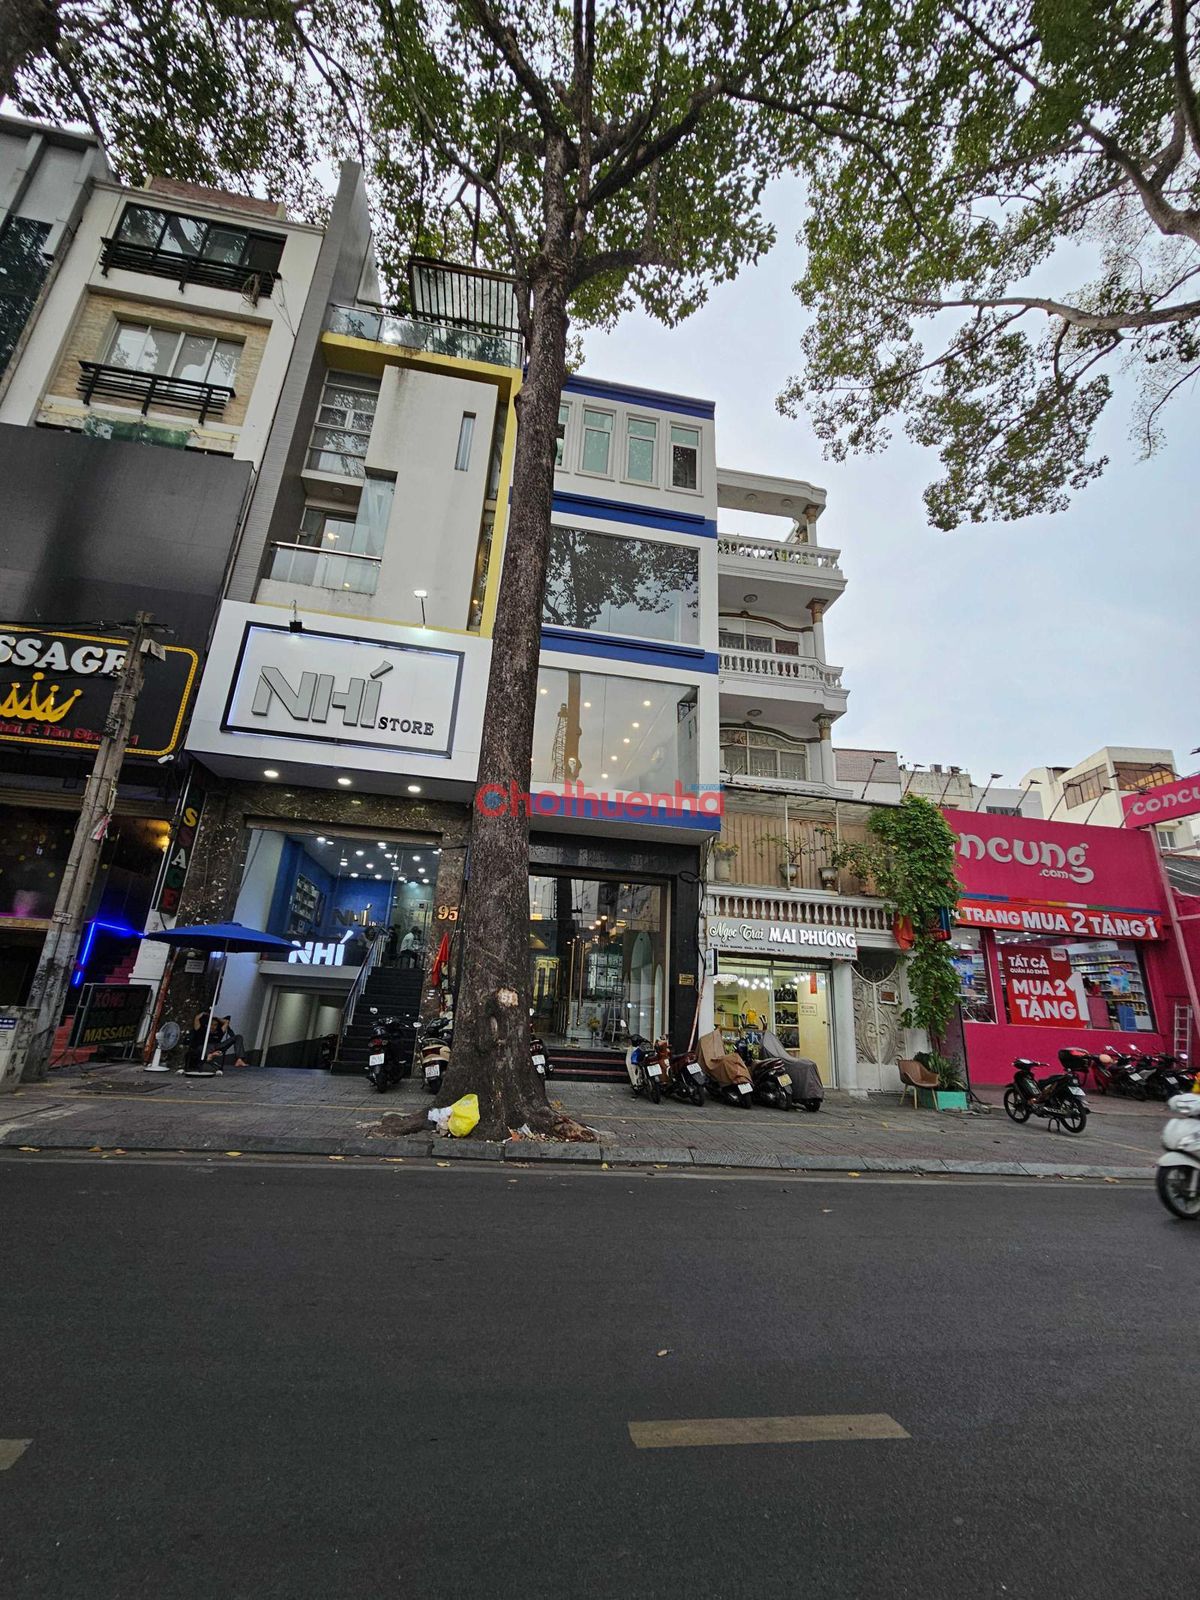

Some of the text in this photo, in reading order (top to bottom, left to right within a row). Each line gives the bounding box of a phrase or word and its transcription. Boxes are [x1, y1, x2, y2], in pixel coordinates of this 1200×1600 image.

[251, 660, 434, 736] NHÍ STORE
[438, 904, 459, 921] 95
[963, 906, 1020, 926] TRANG
[1020, 910, 1071, 932] MUA
[1071, 911, 1089, 933] 2
[1088, 913, 1146, 937] TẶNG
[1146, 917, 1159, 938] 1
[288, 929, 354, 966] NHÍ
[768, 927, 796, 944] MAI
[799, 929, 857, 949] PHƯƠNG
[1007, 953, 1029, 968] TẤT
[1011, 978, 1067, 997] MUA 2
[1016, 995, 1077, 1021] TẶNG
